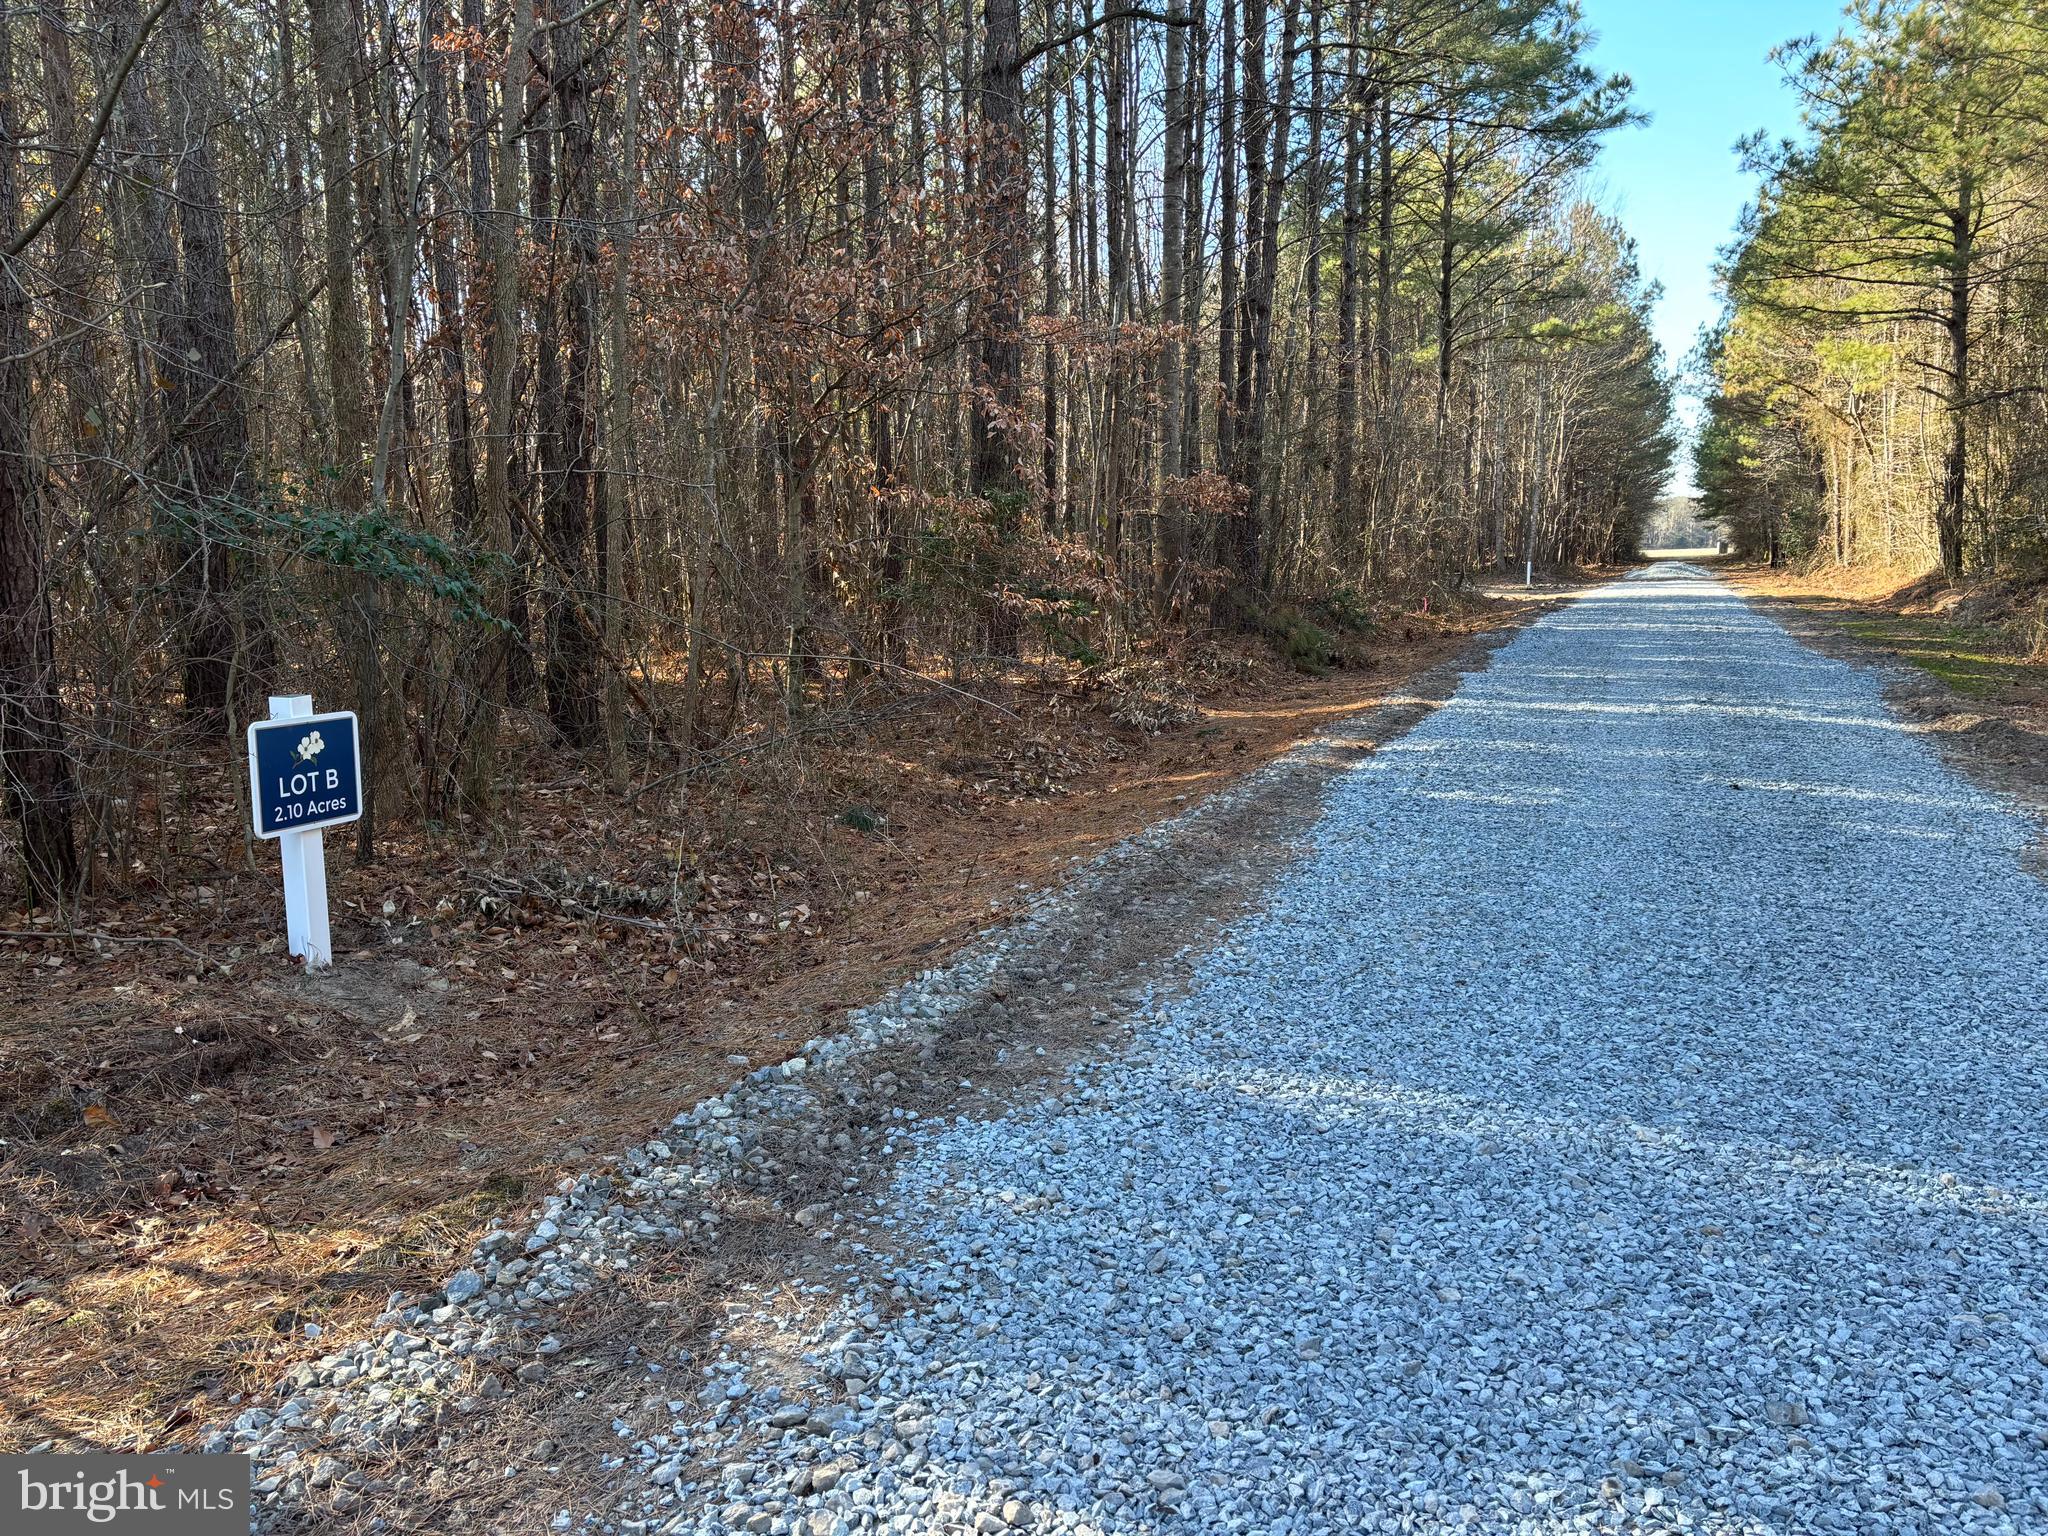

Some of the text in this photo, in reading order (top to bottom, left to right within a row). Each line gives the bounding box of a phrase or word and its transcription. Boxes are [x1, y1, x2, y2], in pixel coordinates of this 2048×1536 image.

[279, 768, 339, 798] LOT B
[274, 797, 347, 822] 2.10 Acres
